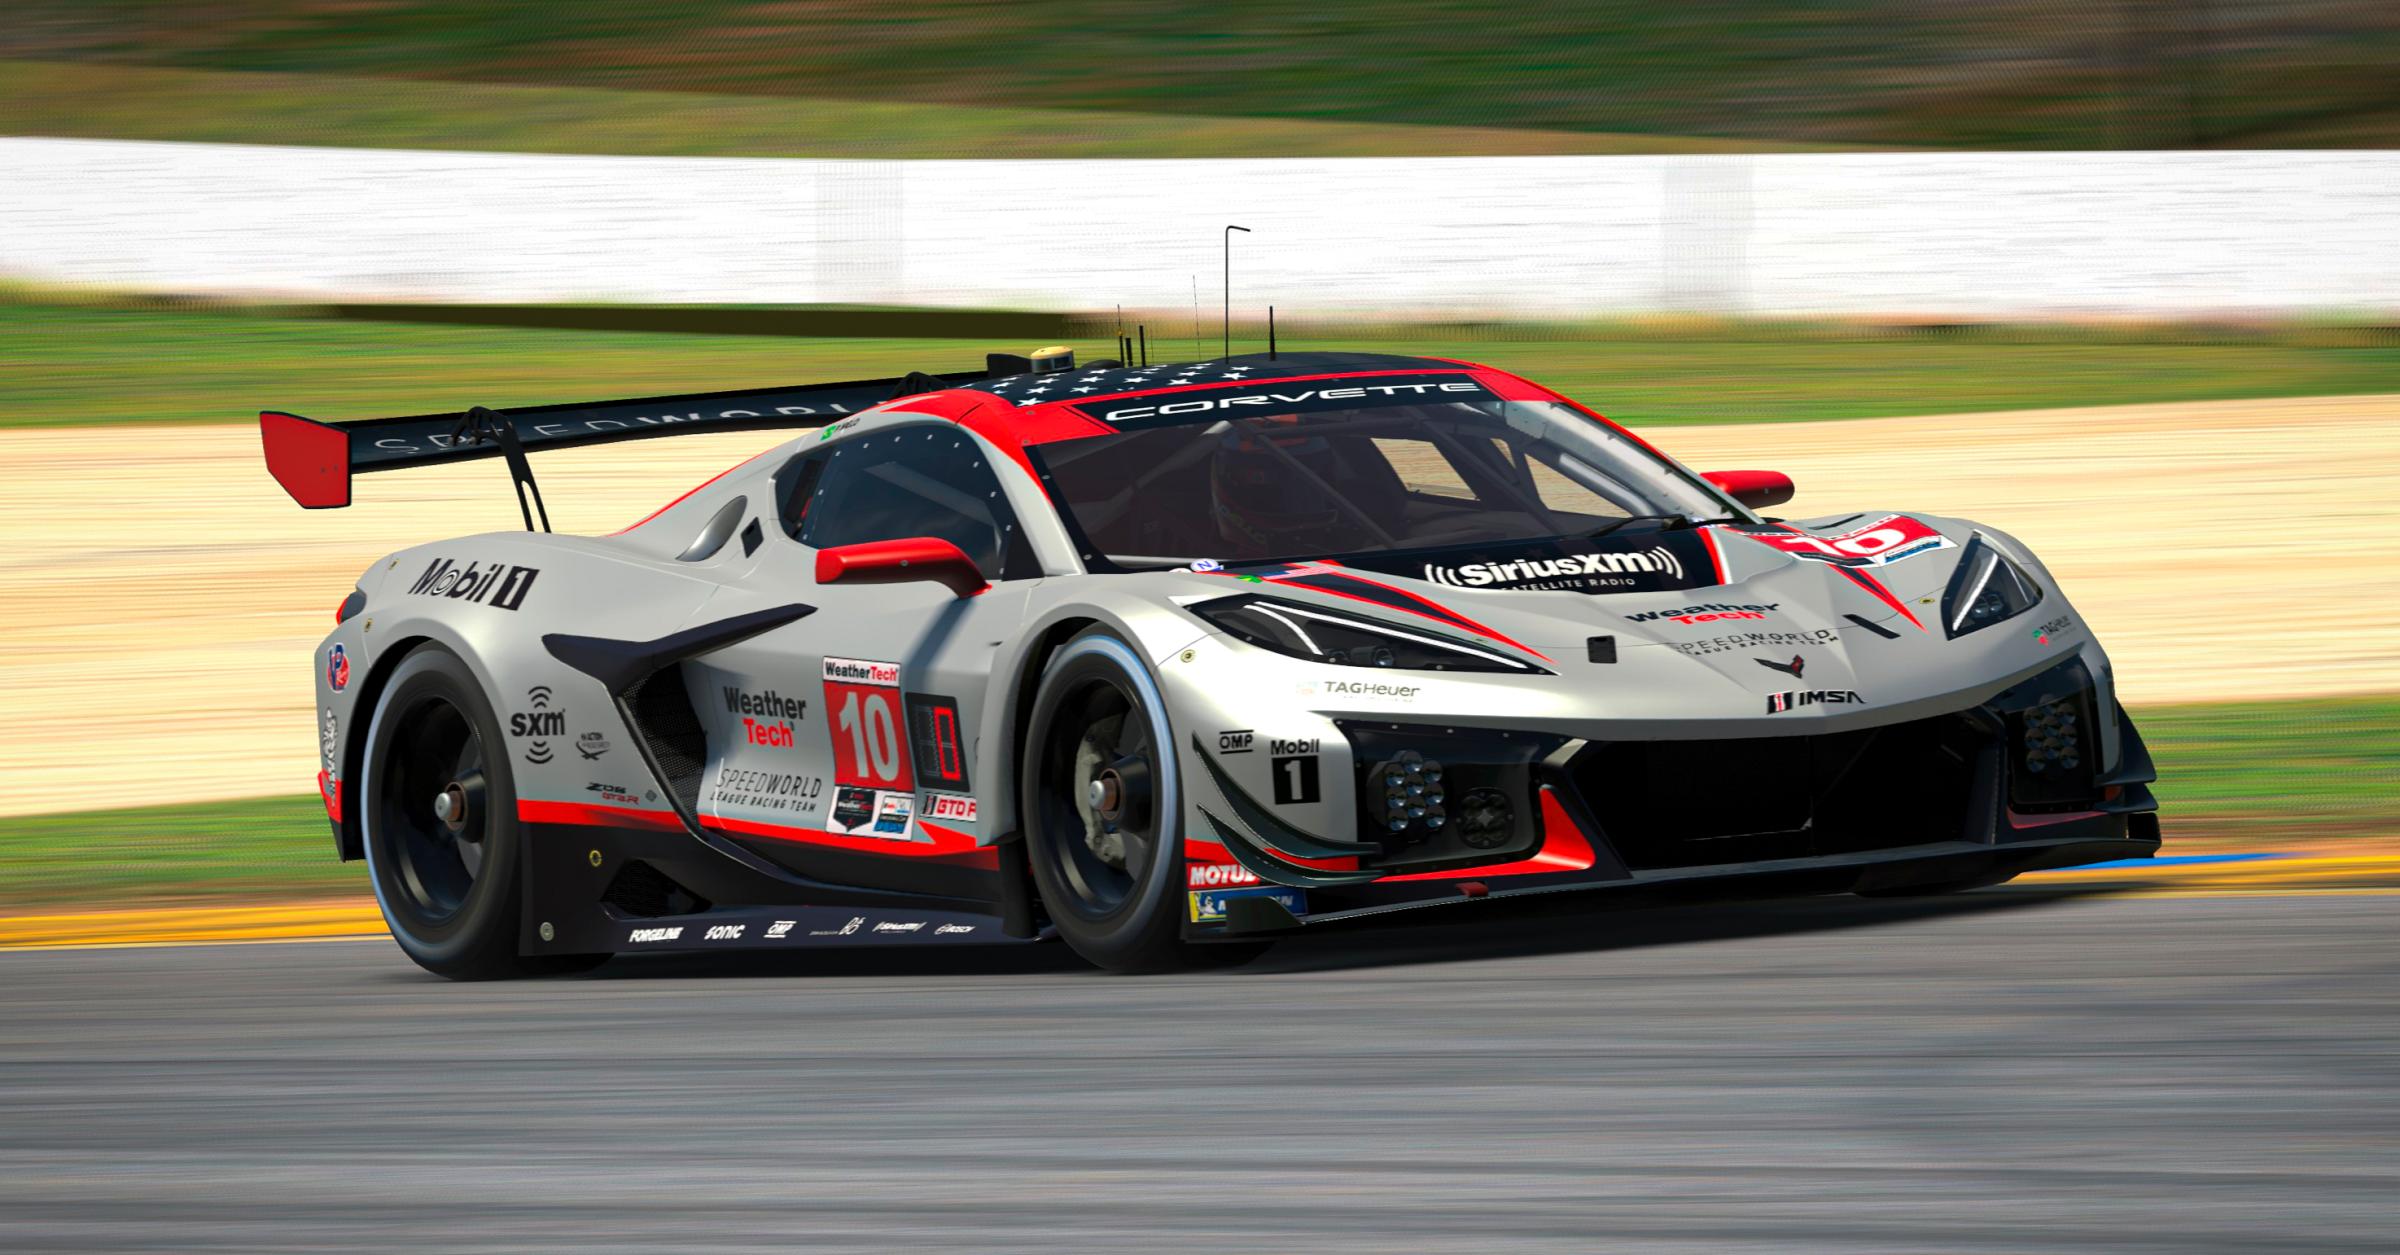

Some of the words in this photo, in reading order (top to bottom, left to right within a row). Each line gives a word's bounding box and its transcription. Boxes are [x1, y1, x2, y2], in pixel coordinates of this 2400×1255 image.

[1105, 381, 1480, 421] CORVETTE
[408, 558, 505, 603] Mobil
[499, 568, 532, 608] 1
[1589, 578, 1636, 587] RADIO
[1624, 603, 1781, 623] Weather
[1668, 611, 1767, 625] Tech
[825, 661, 898, 681] WeatherTech
[723, 686, 806, 720] Weather
[1799, 691, 1866, 704] IMSA
[510, 711, 566, 737] sxm
[742, 718, 794, 748] Tech
[838, 691, 899, 782] 10
[1219, 732, 1254, 752] OMP
[1270, 738, 1320, 755] Mobil
[716, 768, 822, 798] SPEEDWORLD
[1279, 757, 1308, 802] 1
[710, 791, 748, 805] LEAGUE
[750, 796, 786, 809] RACING
[791, 800, 816, 812] TEAM
[937, 798, 967, 816] GTD
[704, 924, 746, 940] SONIC
